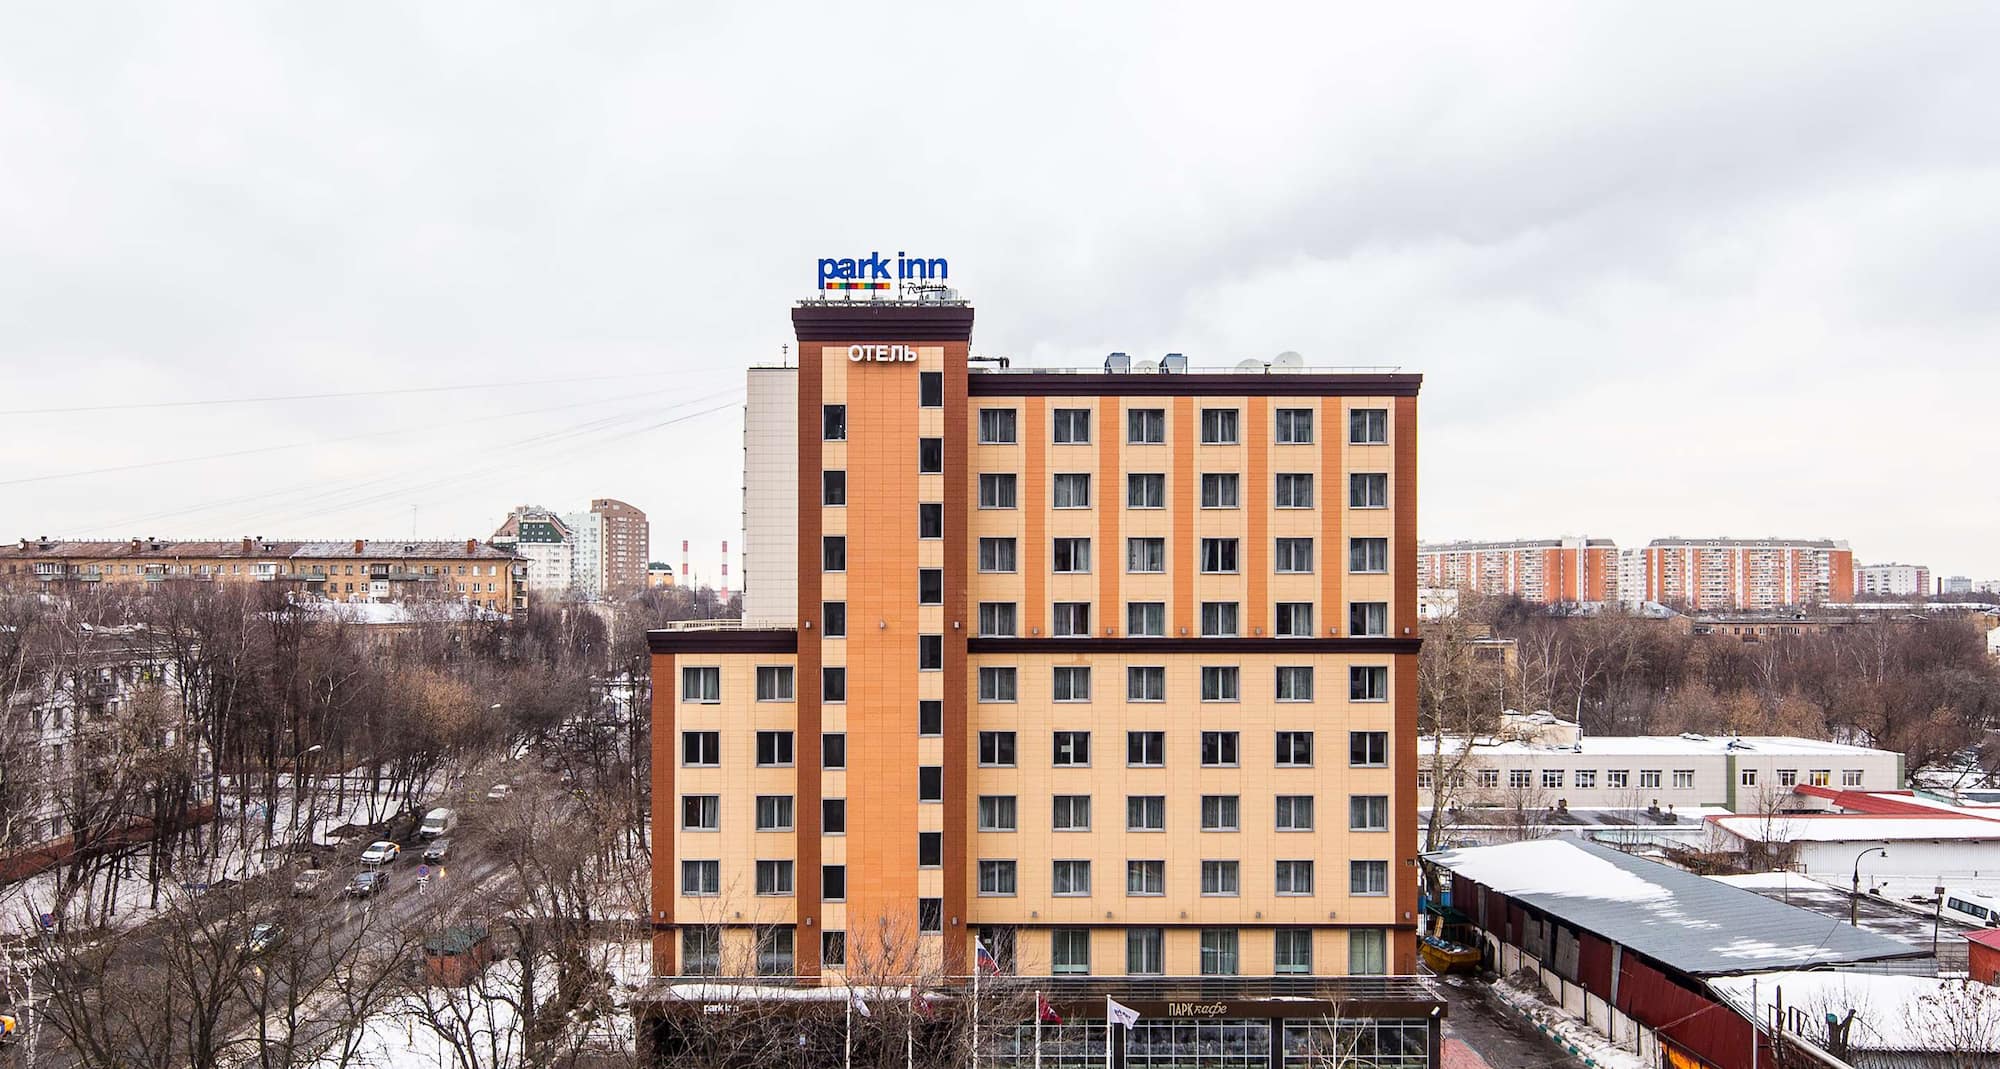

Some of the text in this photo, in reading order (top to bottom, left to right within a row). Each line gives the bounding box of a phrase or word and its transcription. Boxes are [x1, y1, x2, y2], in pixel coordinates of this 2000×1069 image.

[818, 252, 948, 289] park inn
[847, 345, 918, 362] ОТЕЛЬ
[1168, 1003, 1194, 1016] ПАРК
